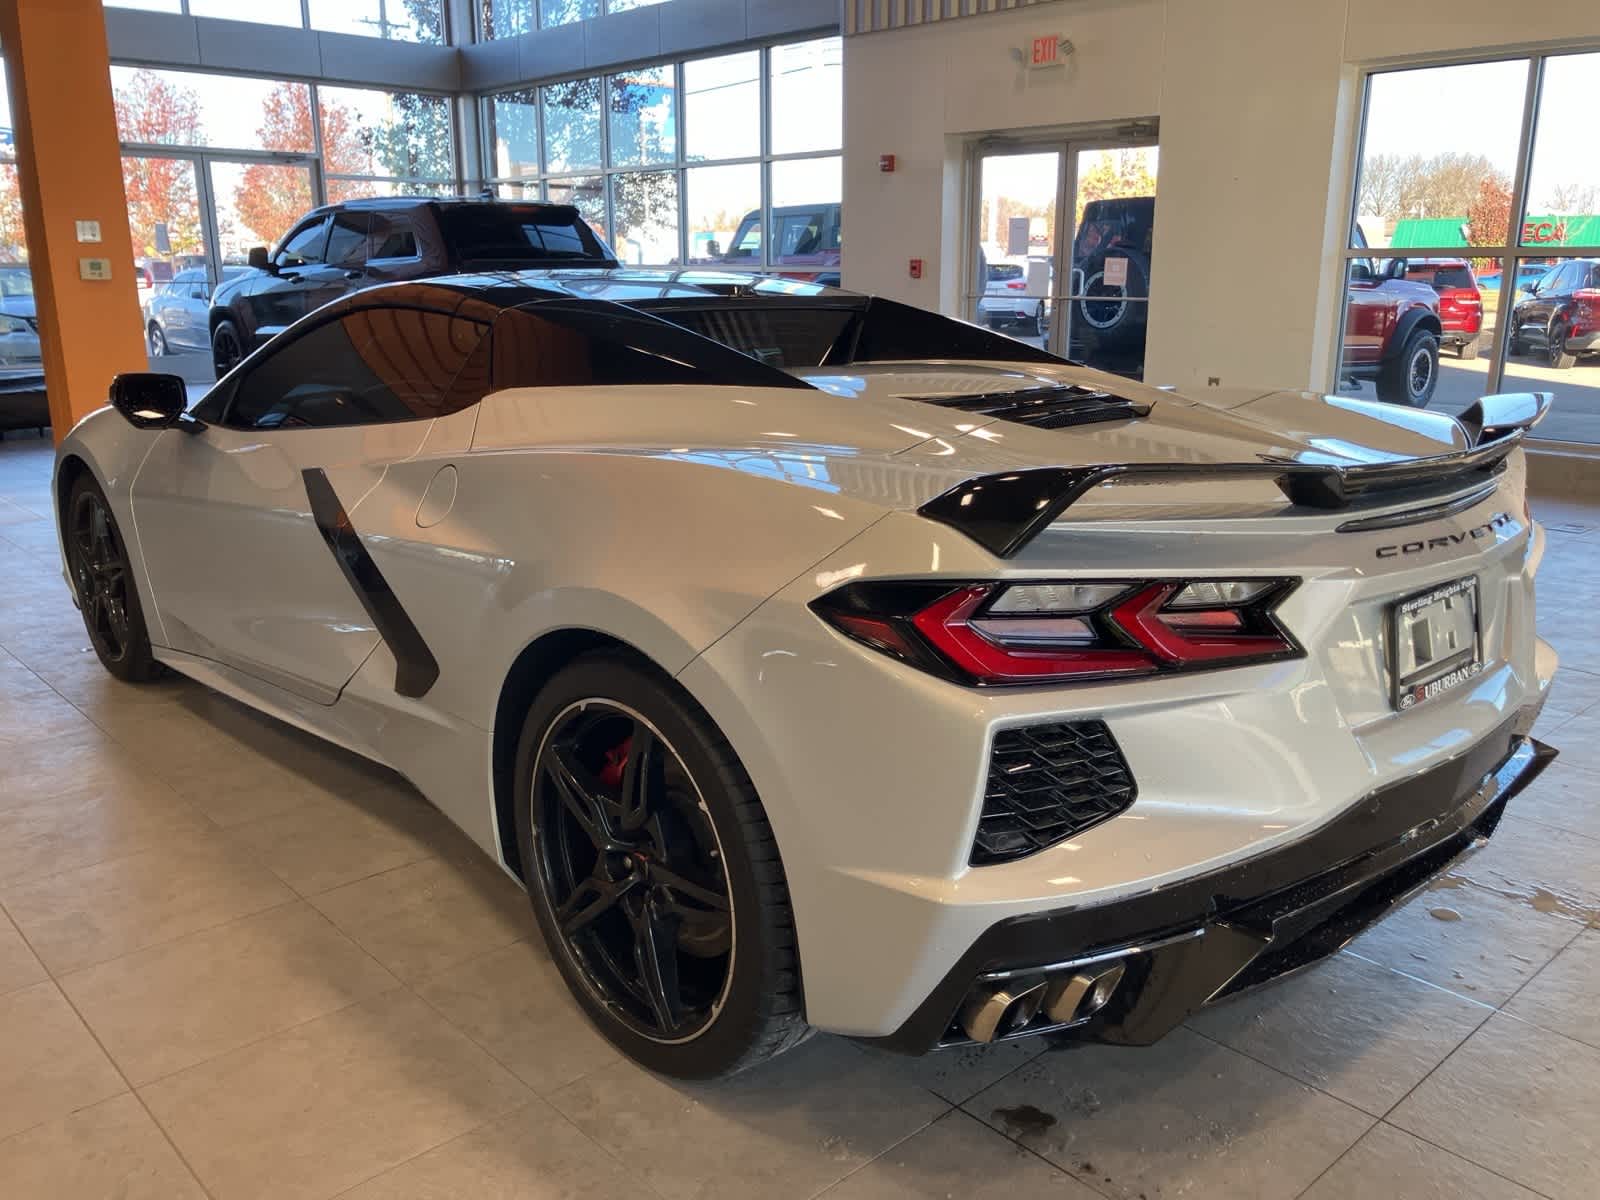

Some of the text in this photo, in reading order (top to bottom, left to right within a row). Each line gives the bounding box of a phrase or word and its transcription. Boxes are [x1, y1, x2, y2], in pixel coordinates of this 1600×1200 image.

[1032, 36, 1057, 64] EXIT
[1402, 576, 1477, 614] Sterling Heights Ford
[1415, 666, 1470, 701] SUBURBAN
